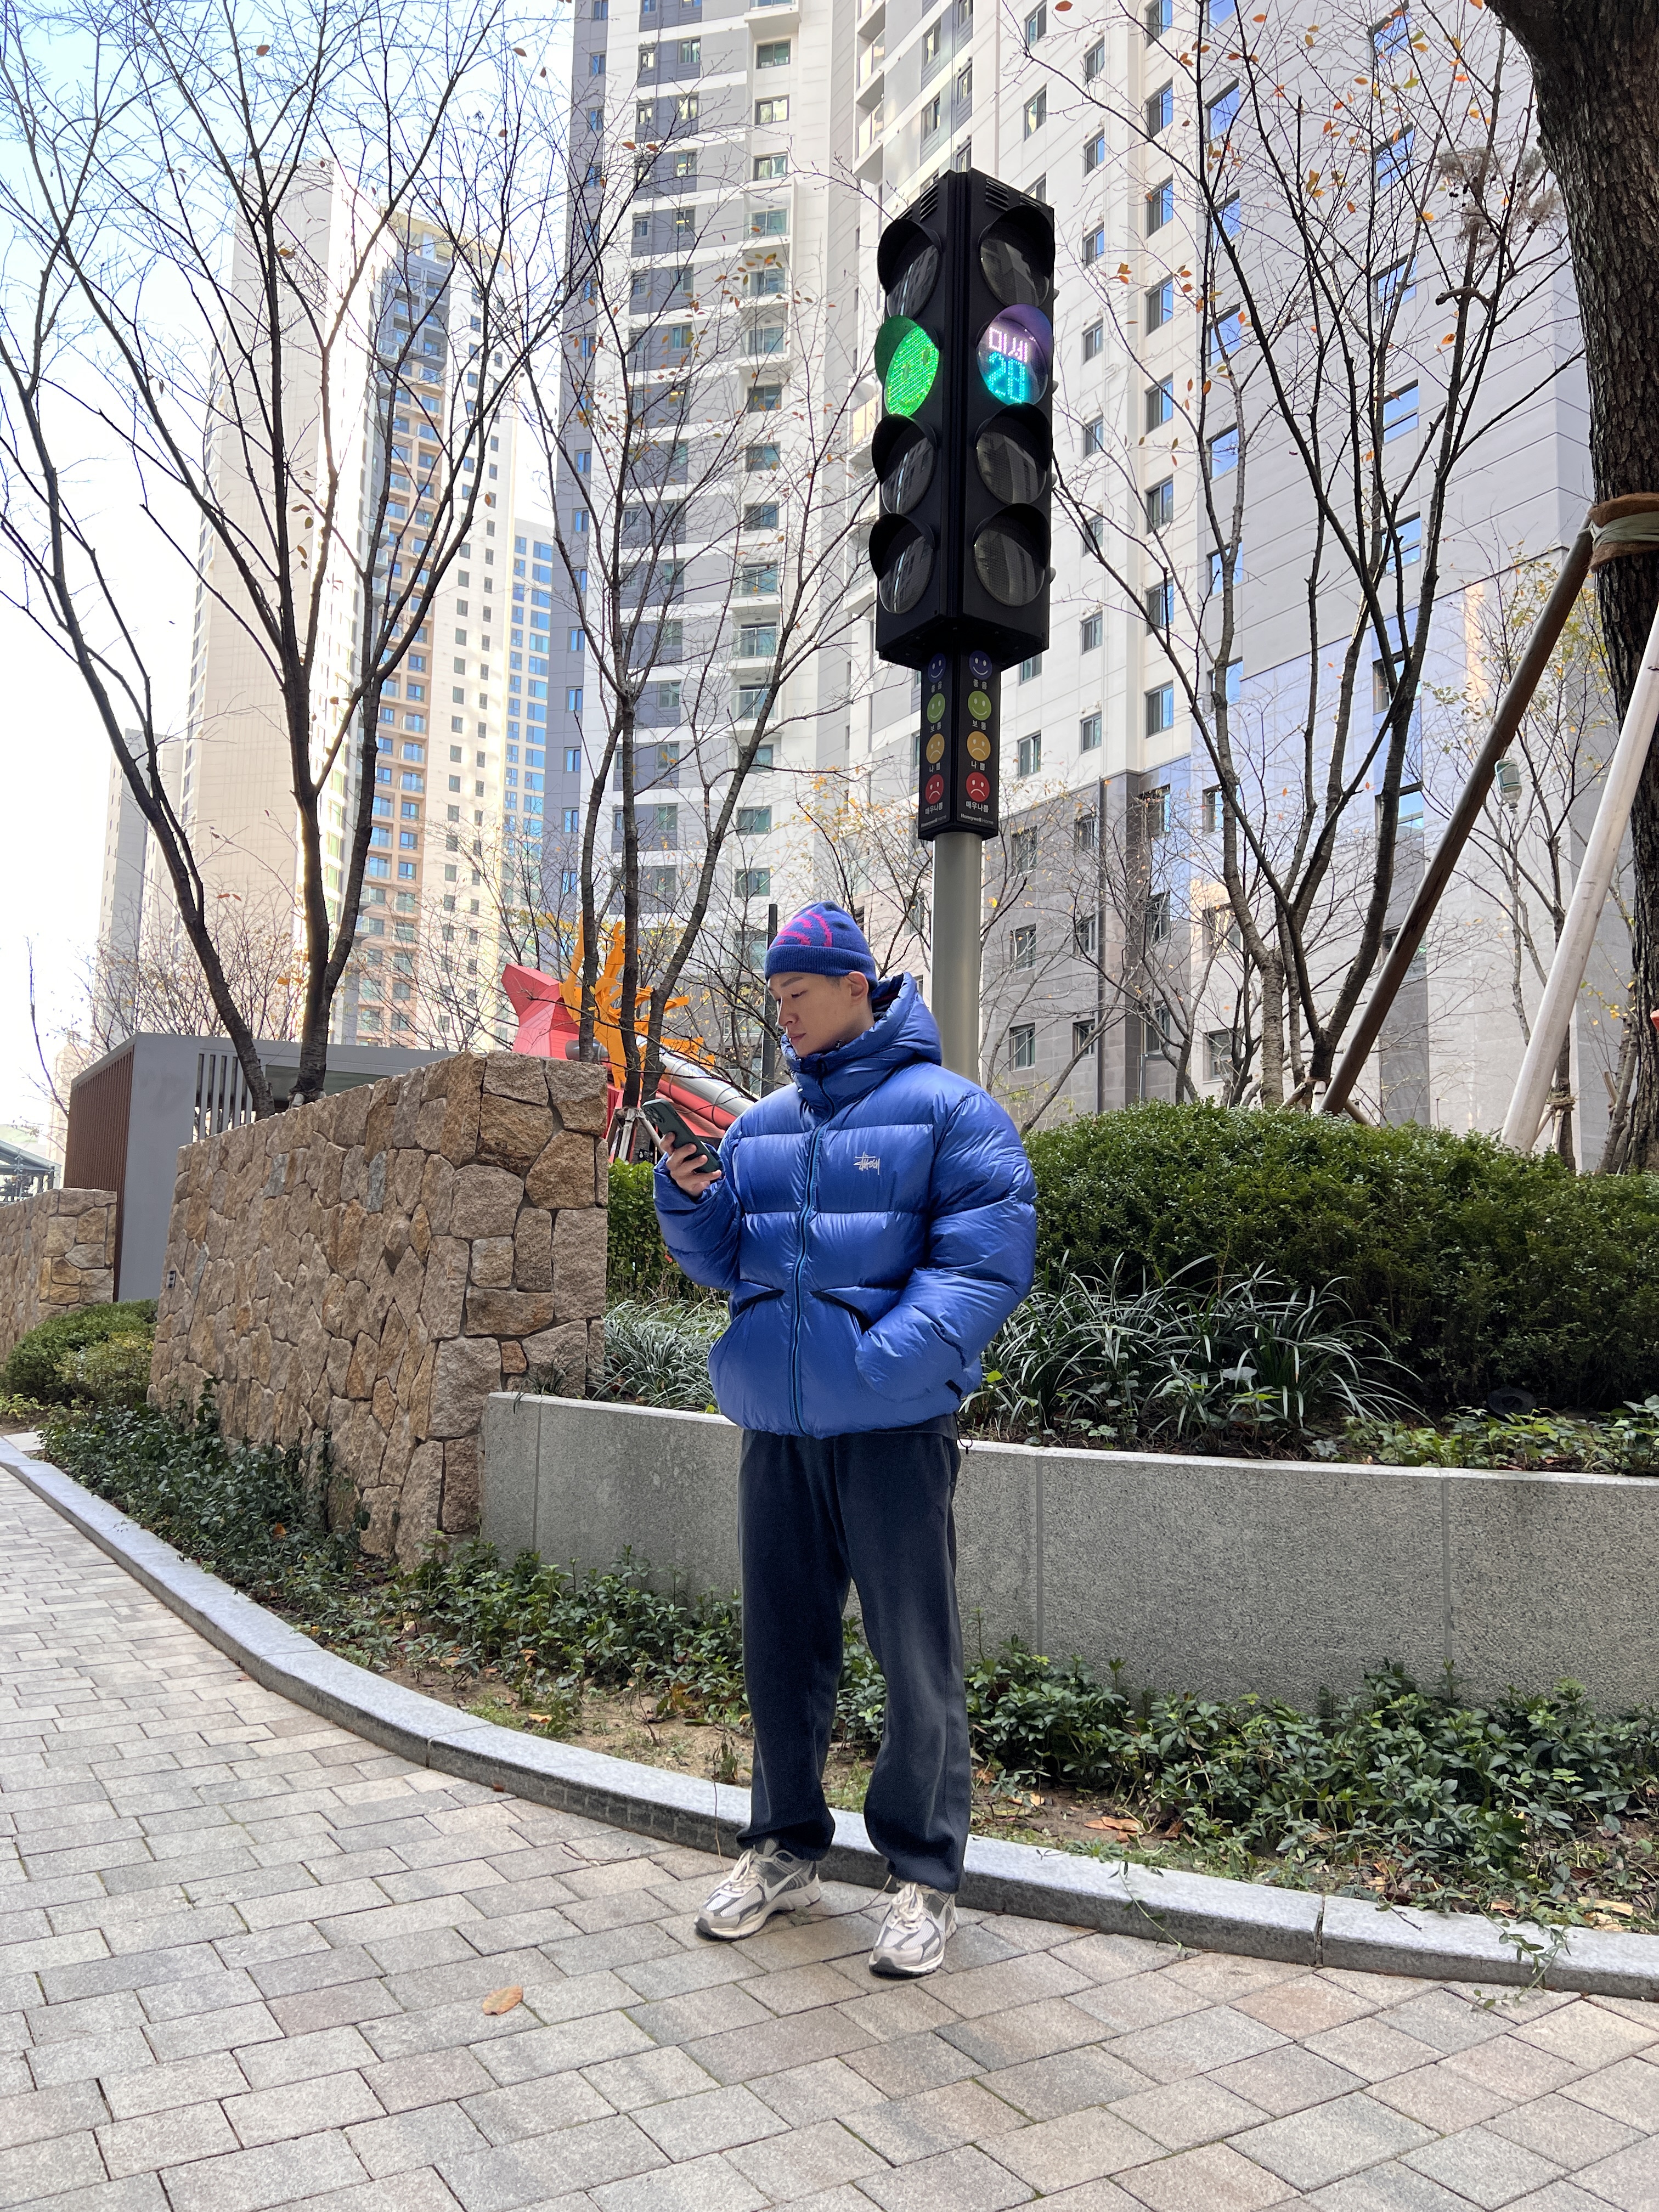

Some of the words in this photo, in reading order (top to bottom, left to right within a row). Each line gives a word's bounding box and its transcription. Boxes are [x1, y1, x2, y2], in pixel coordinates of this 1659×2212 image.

[989, 327, 1028, 363] 미세
[966, 801, 989, 813] 매우나쁨
[921, 818, 938, 828] Honeywell
[961, 813, 981, 822] Honeywell
